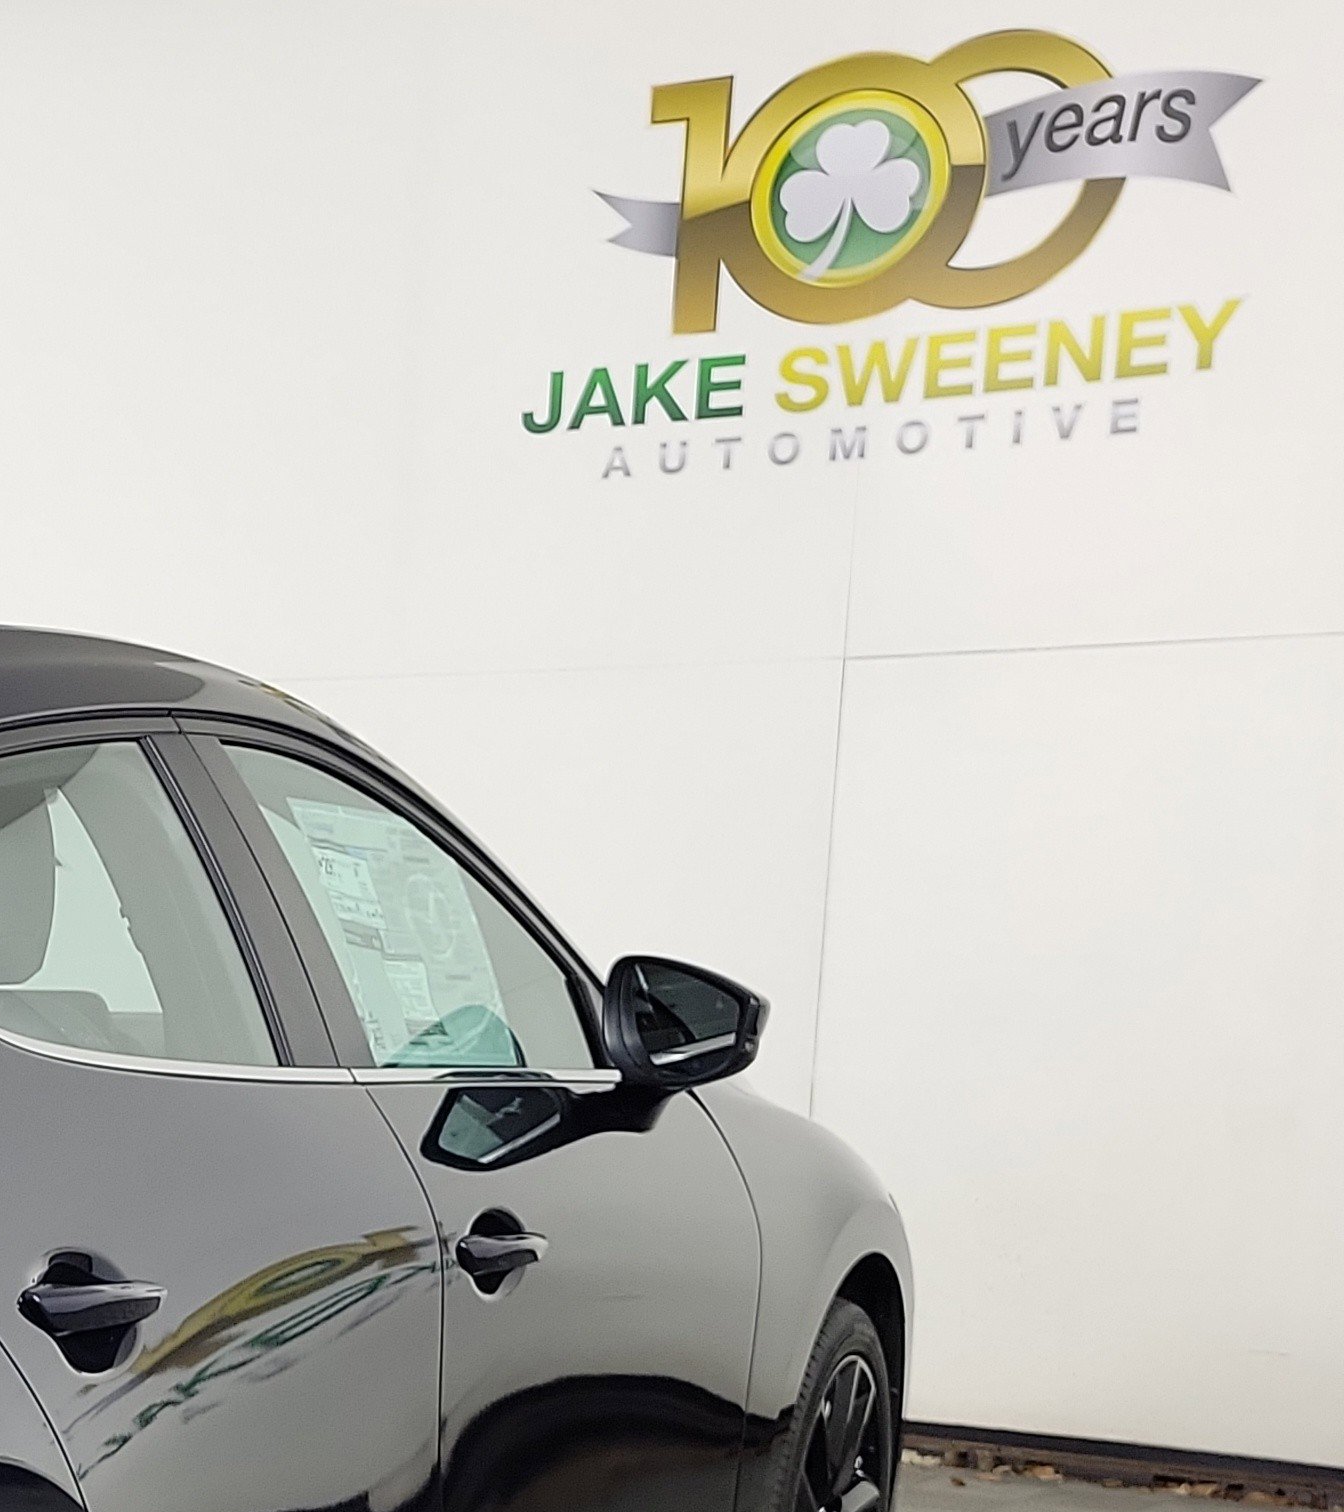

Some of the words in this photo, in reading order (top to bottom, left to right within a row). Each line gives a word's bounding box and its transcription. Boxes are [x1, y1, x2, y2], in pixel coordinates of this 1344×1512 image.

[651, 29, 1125, 335] 100
[1002, 88, 1197, 180] years
[522, 354, 747, 434] JAKE
[774, 298, 1243, 414] SWEENEY
[602, 398, 1140, 480] AUTOMOTIVE
